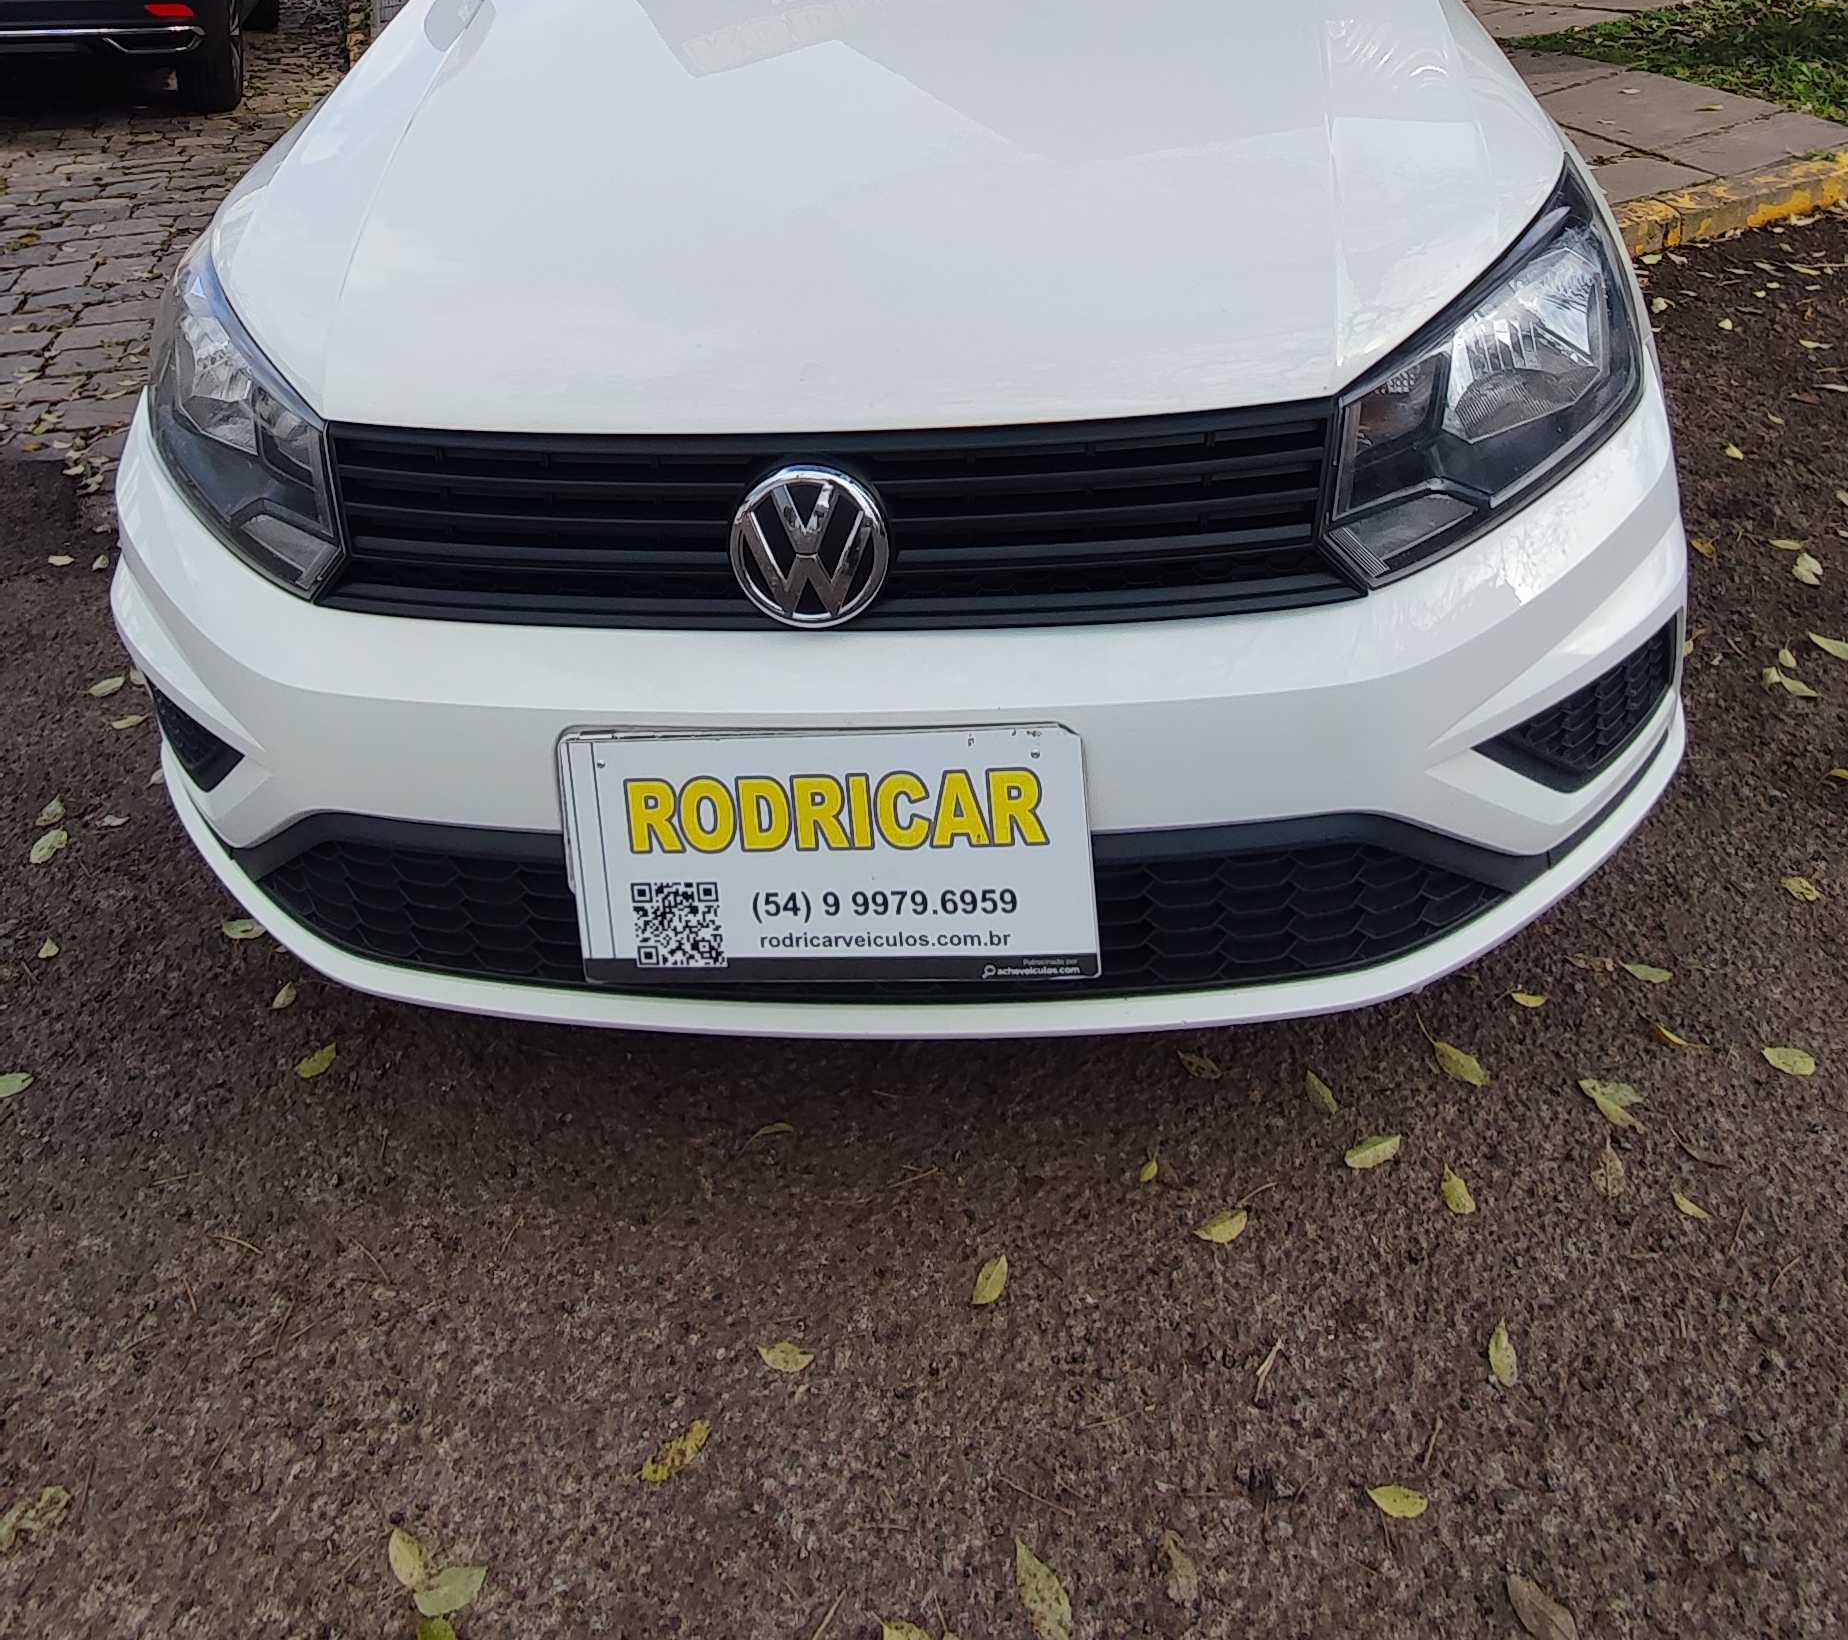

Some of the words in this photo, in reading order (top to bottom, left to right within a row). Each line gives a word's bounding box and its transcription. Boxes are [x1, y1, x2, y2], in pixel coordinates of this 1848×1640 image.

[623, 767, 1050, 854] RODRICAR
[752, 891, 812, 923] (54)
[822, 892, 840, 916] 9
[851, 889, 1018, 916] 9979.6959
[759, 930, 1012, 948] rodricarveiculos.com.br
